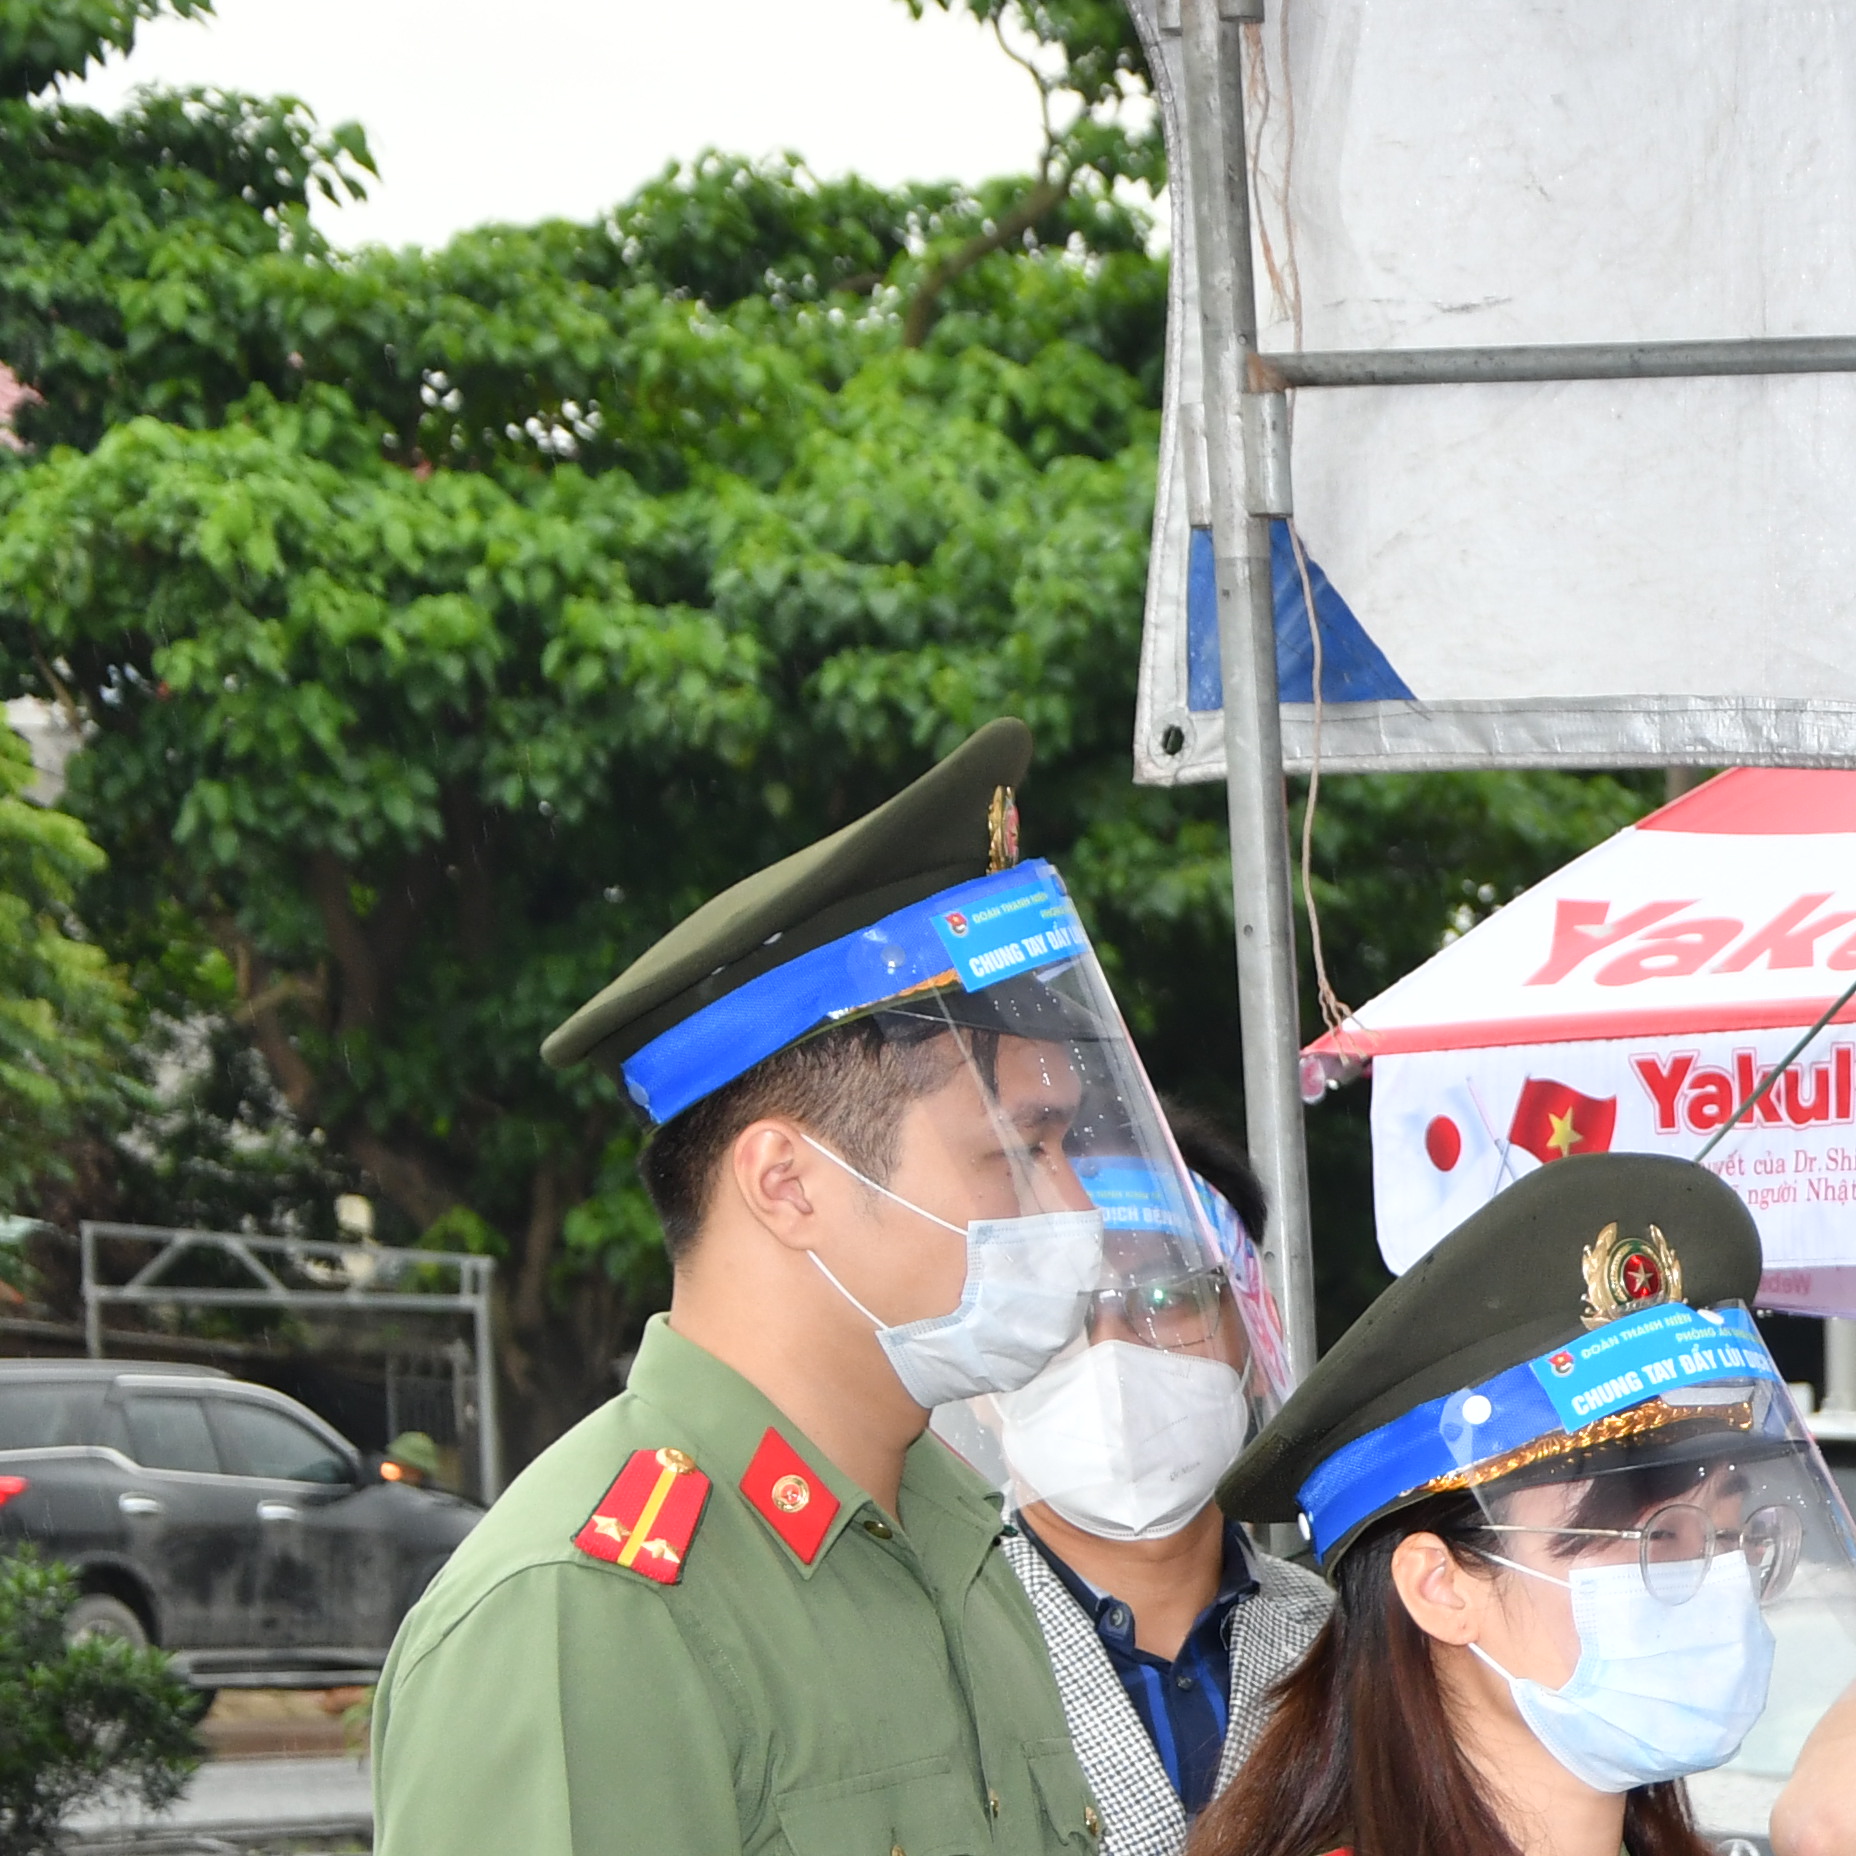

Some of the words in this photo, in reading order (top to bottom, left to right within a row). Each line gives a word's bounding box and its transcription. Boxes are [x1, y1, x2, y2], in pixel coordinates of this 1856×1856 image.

[969, 943, 1026, 978] CHUNG
[1021, 934, 1047, 958] TAY
[1753, 1151, 1787, 1176] của
[1748, 1181, 1797, 1210] người
[1571, 1371, 1644, 1416] CHUNG
[1641, 1358, 1678, 1385] TAY
